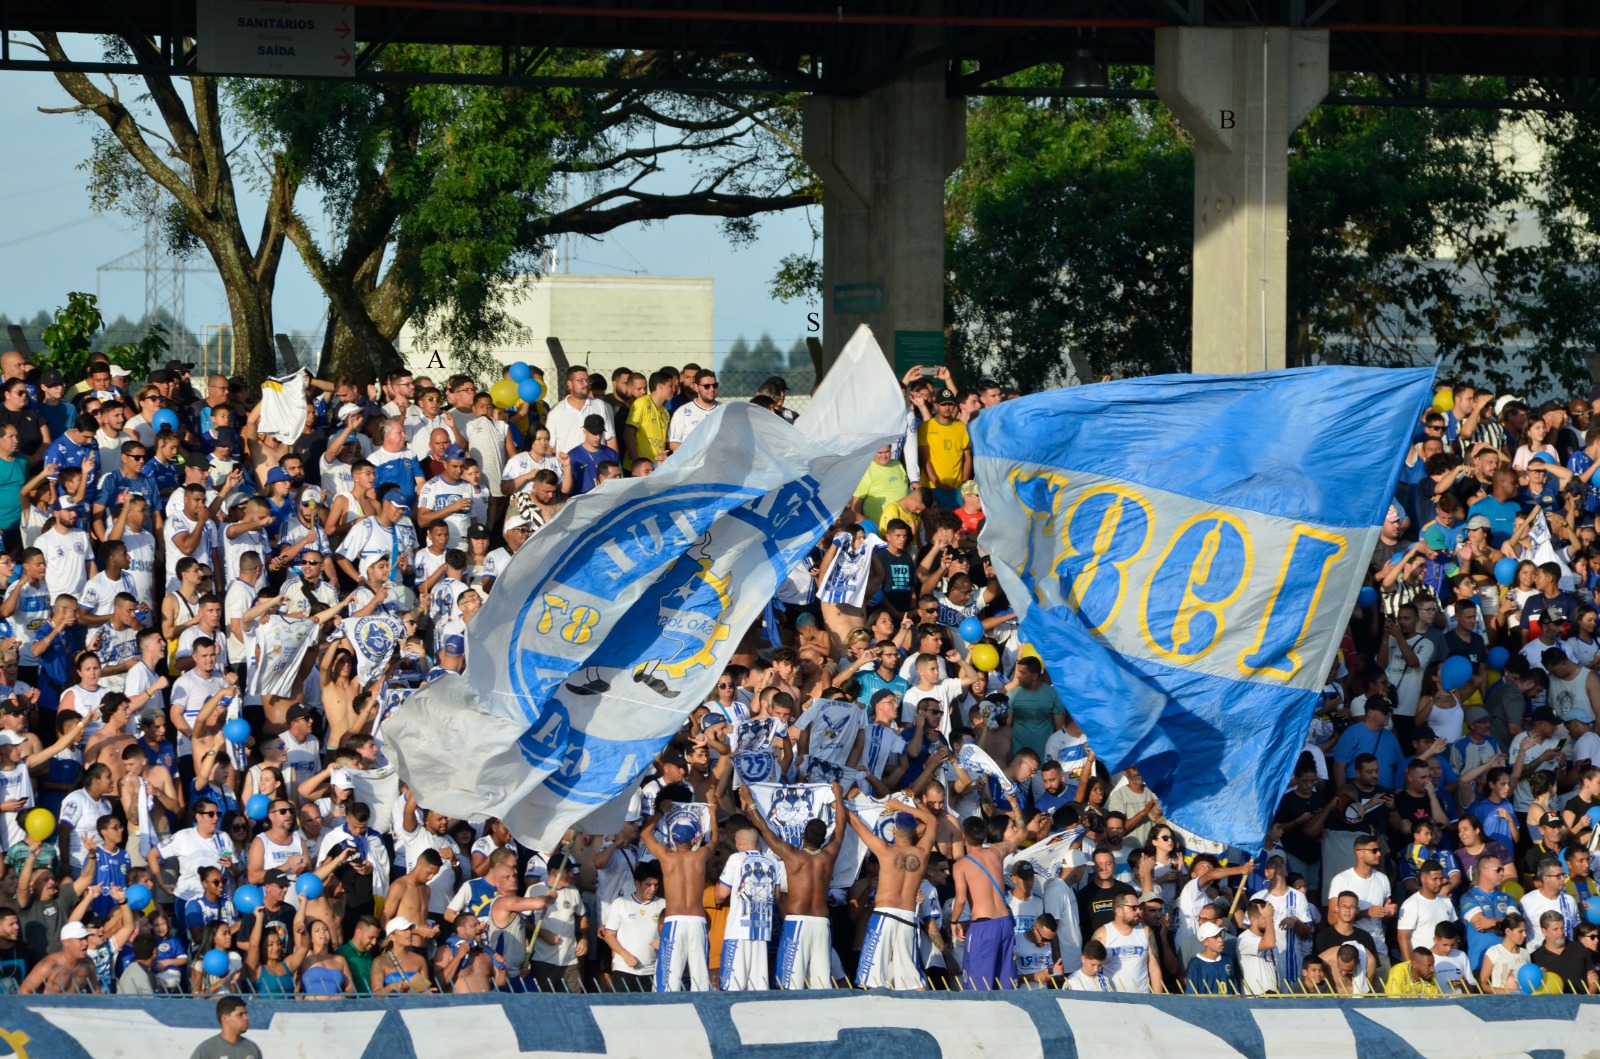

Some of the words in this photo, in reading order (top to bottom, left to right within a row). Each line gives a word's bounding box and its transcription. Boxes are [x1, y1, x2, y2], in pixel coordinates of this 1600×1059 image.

[238, 16, 315, 30] SANITÁRIOS
[257, 44, 296, 57] SAÍDA
[893, 567, 908, 576] HD
